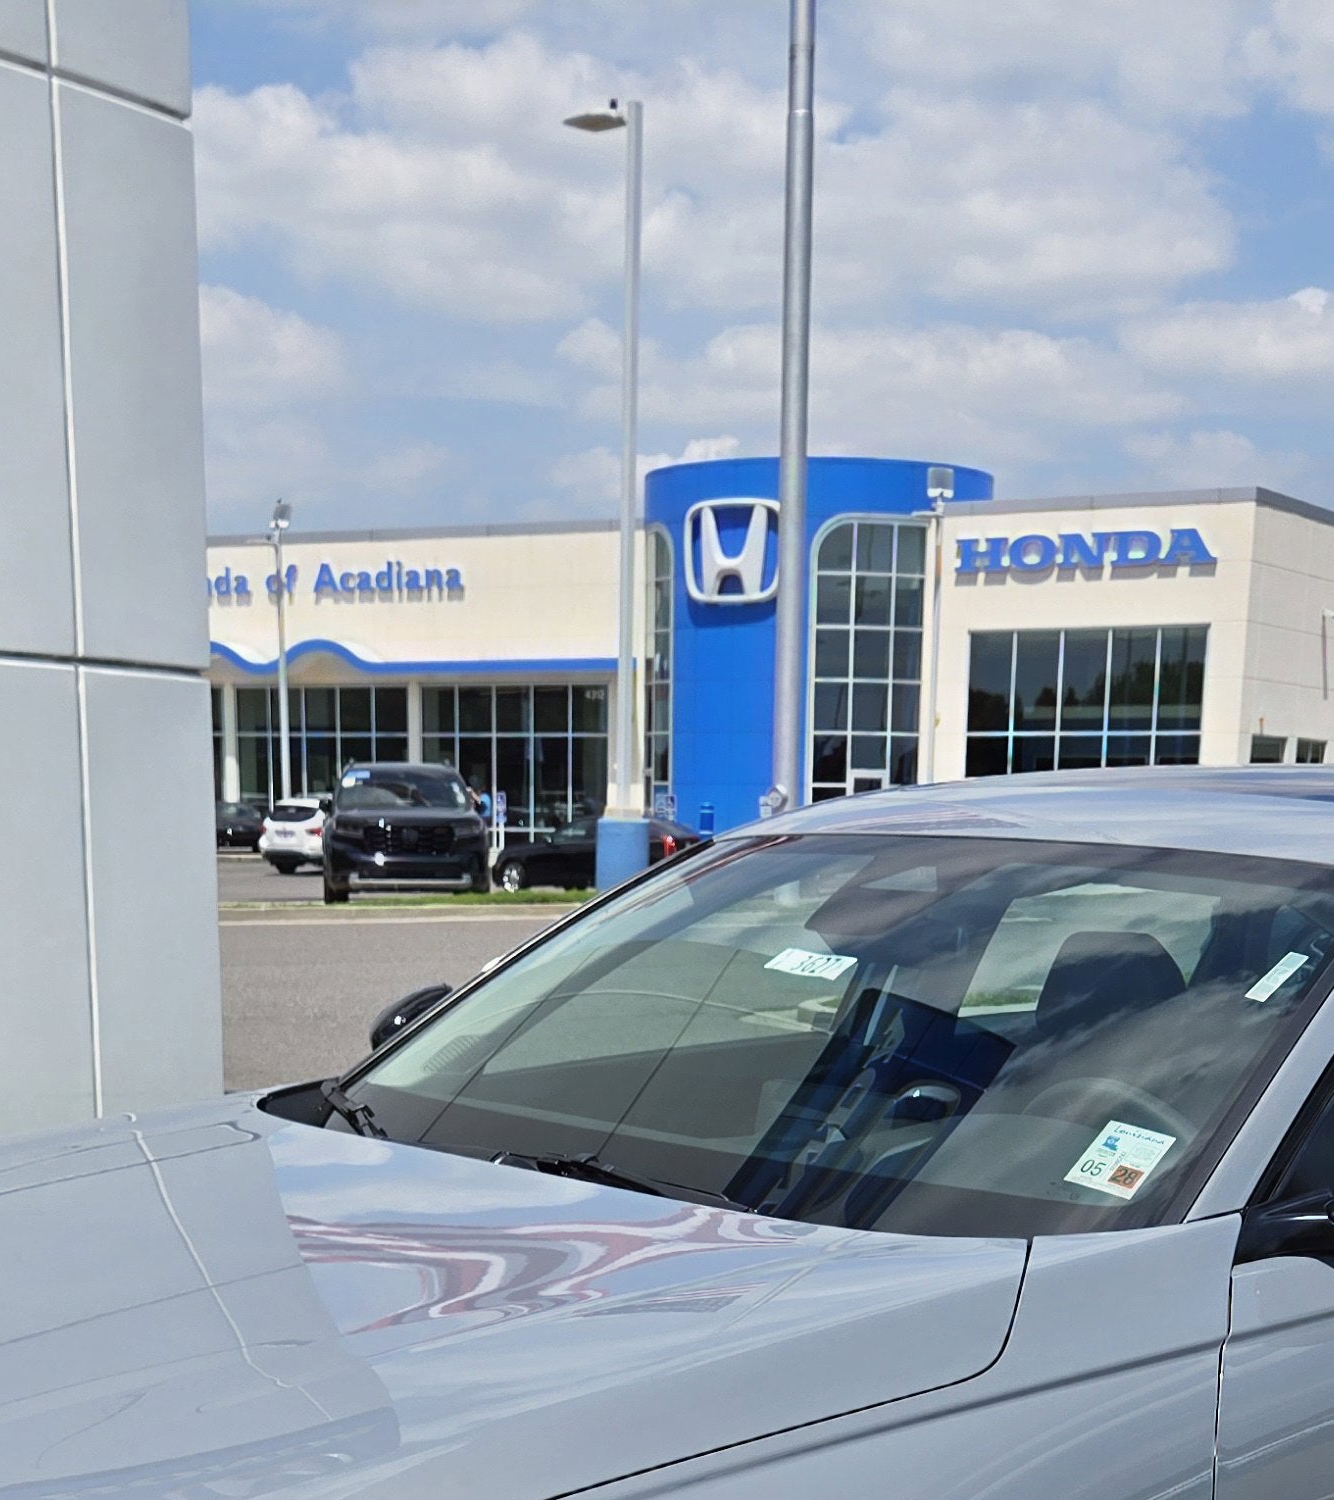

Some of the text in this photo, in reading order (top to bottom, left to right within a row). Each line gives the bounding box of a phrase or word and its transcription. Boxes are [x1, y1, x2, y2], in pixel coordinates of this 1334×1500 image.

[956, 527, 1217, 575] HONDA
[266, 564, 297, 594] of
[313, 560, 463, 594] Acadiana
[1080, 1159, 1107, 1177] 05
